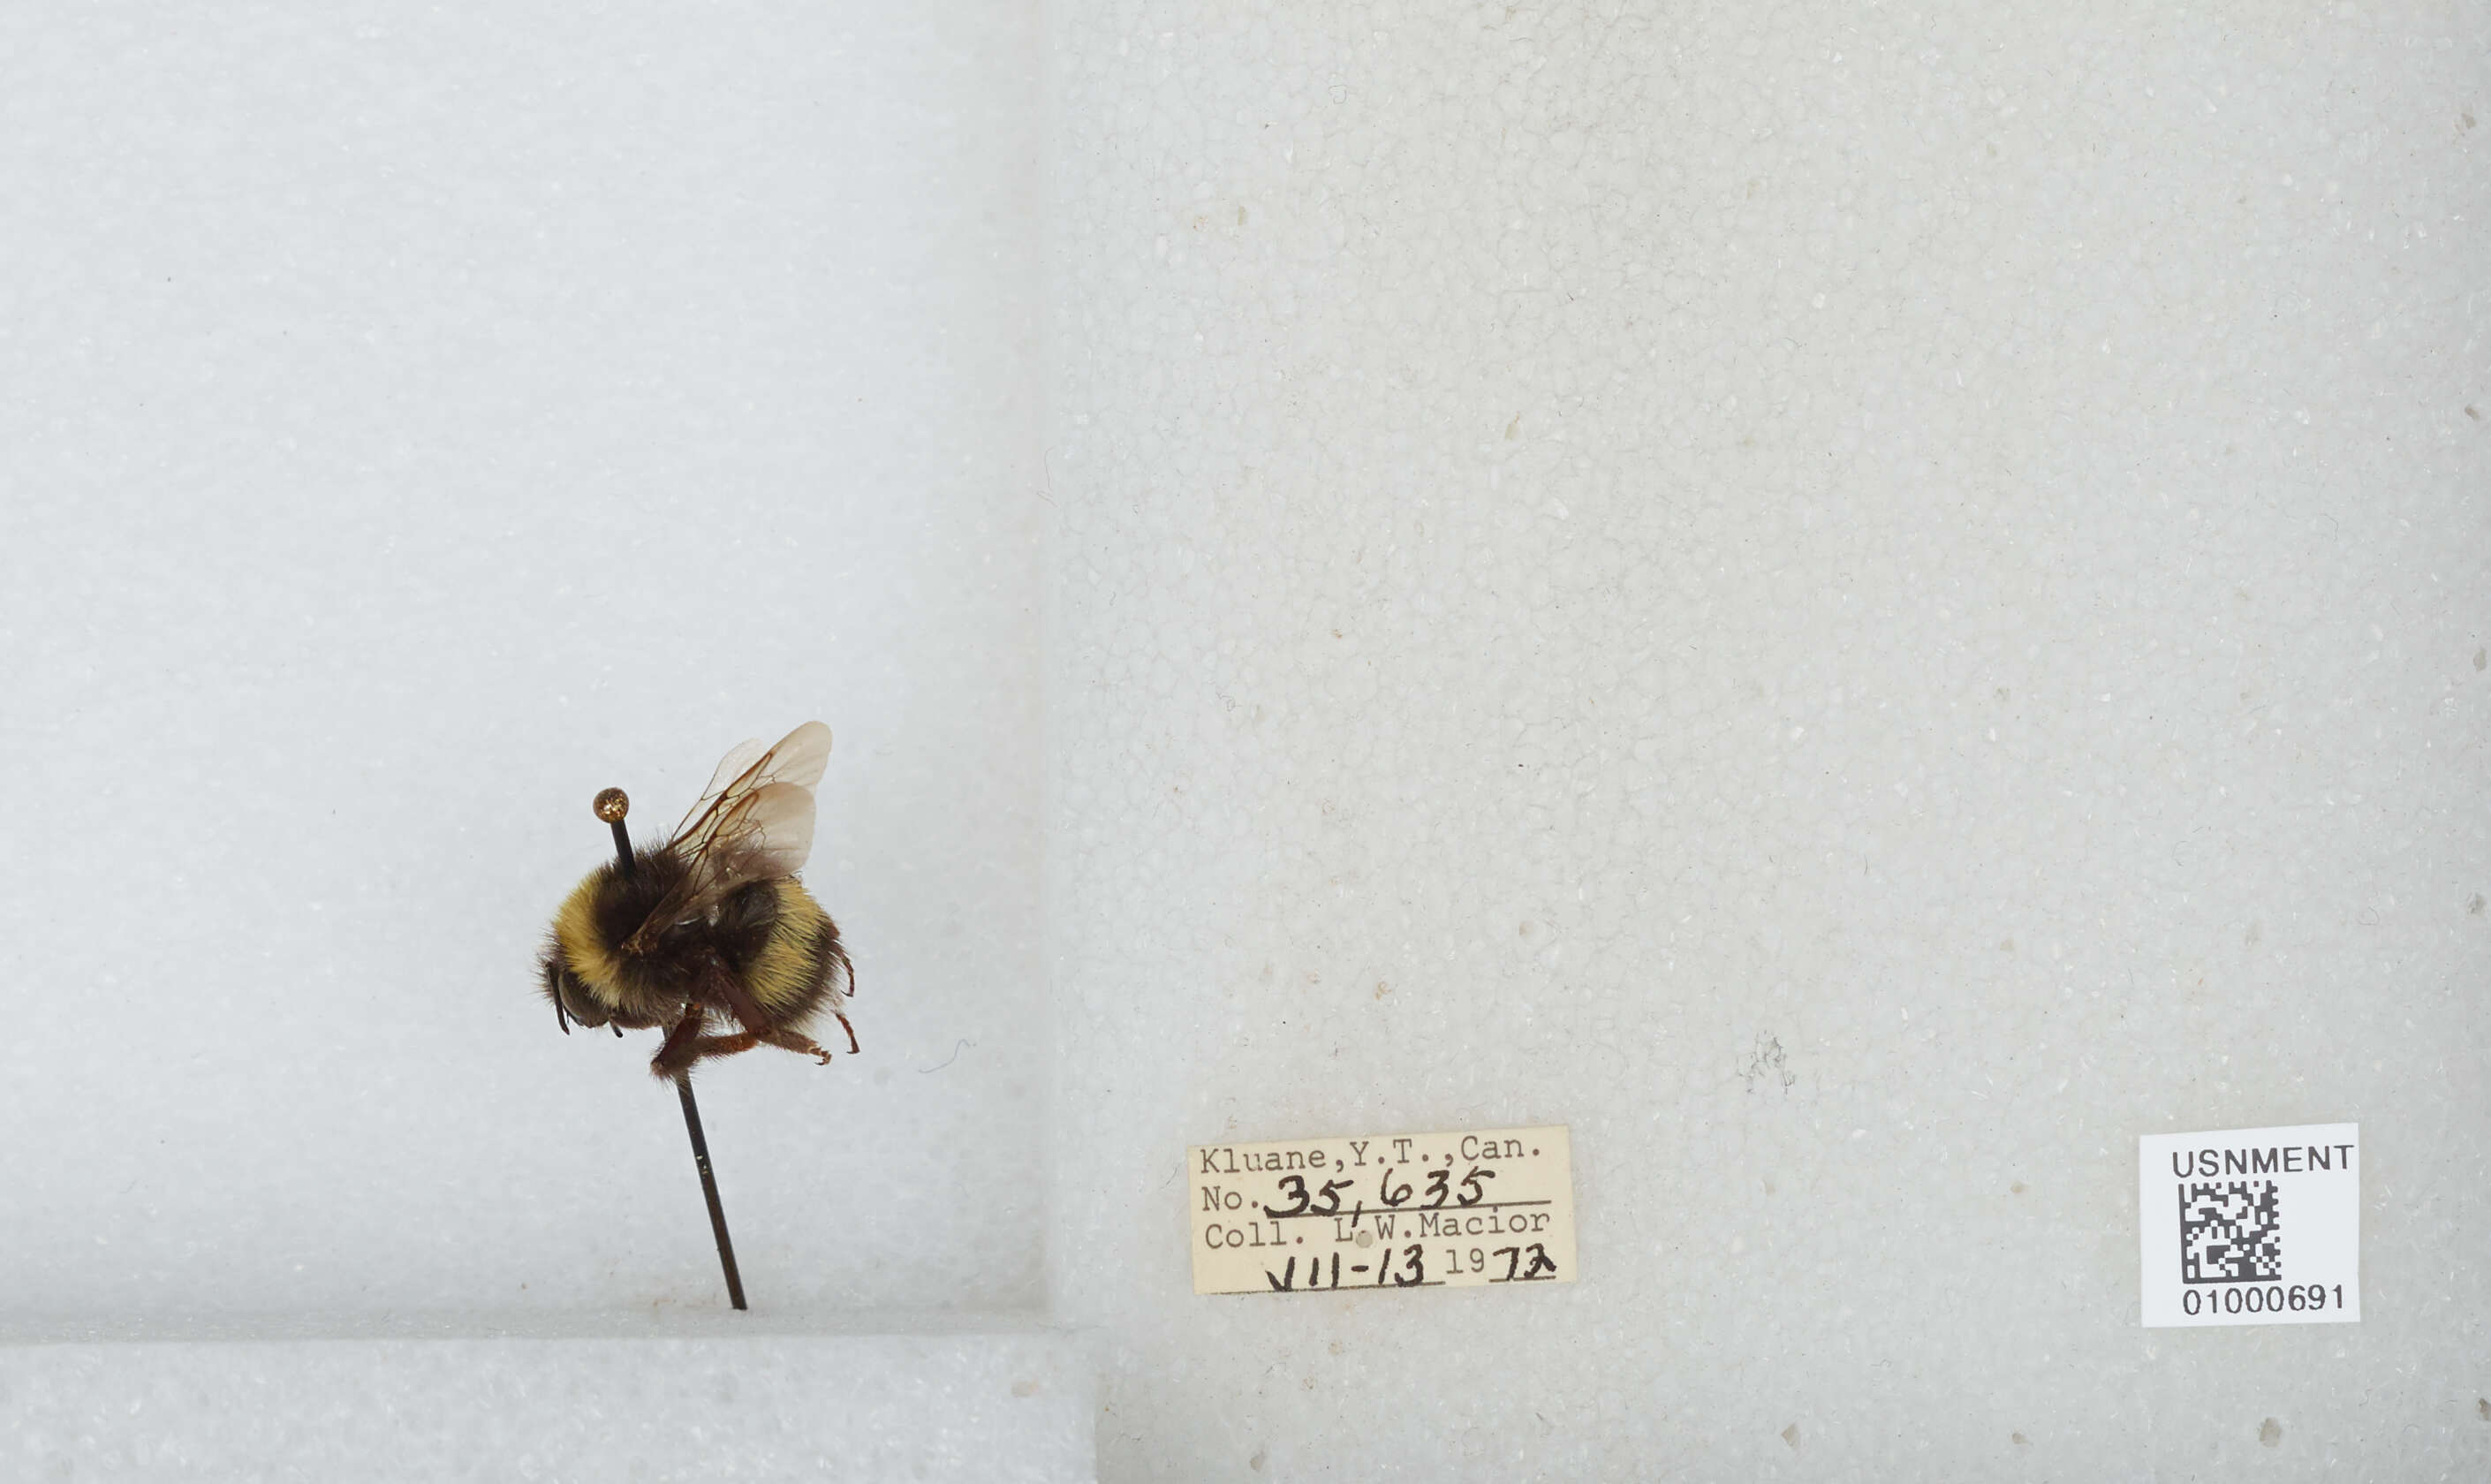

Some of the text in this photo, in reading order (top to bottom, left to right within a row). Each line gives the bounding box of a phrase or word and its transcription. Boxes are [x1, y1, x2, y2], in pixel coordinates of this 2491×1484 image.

[2172, 1145, 2355, 1178] USNMENT
[1201, 1185, 1259, 1211] No.
[1205, 1206, 1550, 1249] Coll. LW.Macior
[2183, 1284, 2343, 1315] 01000691
